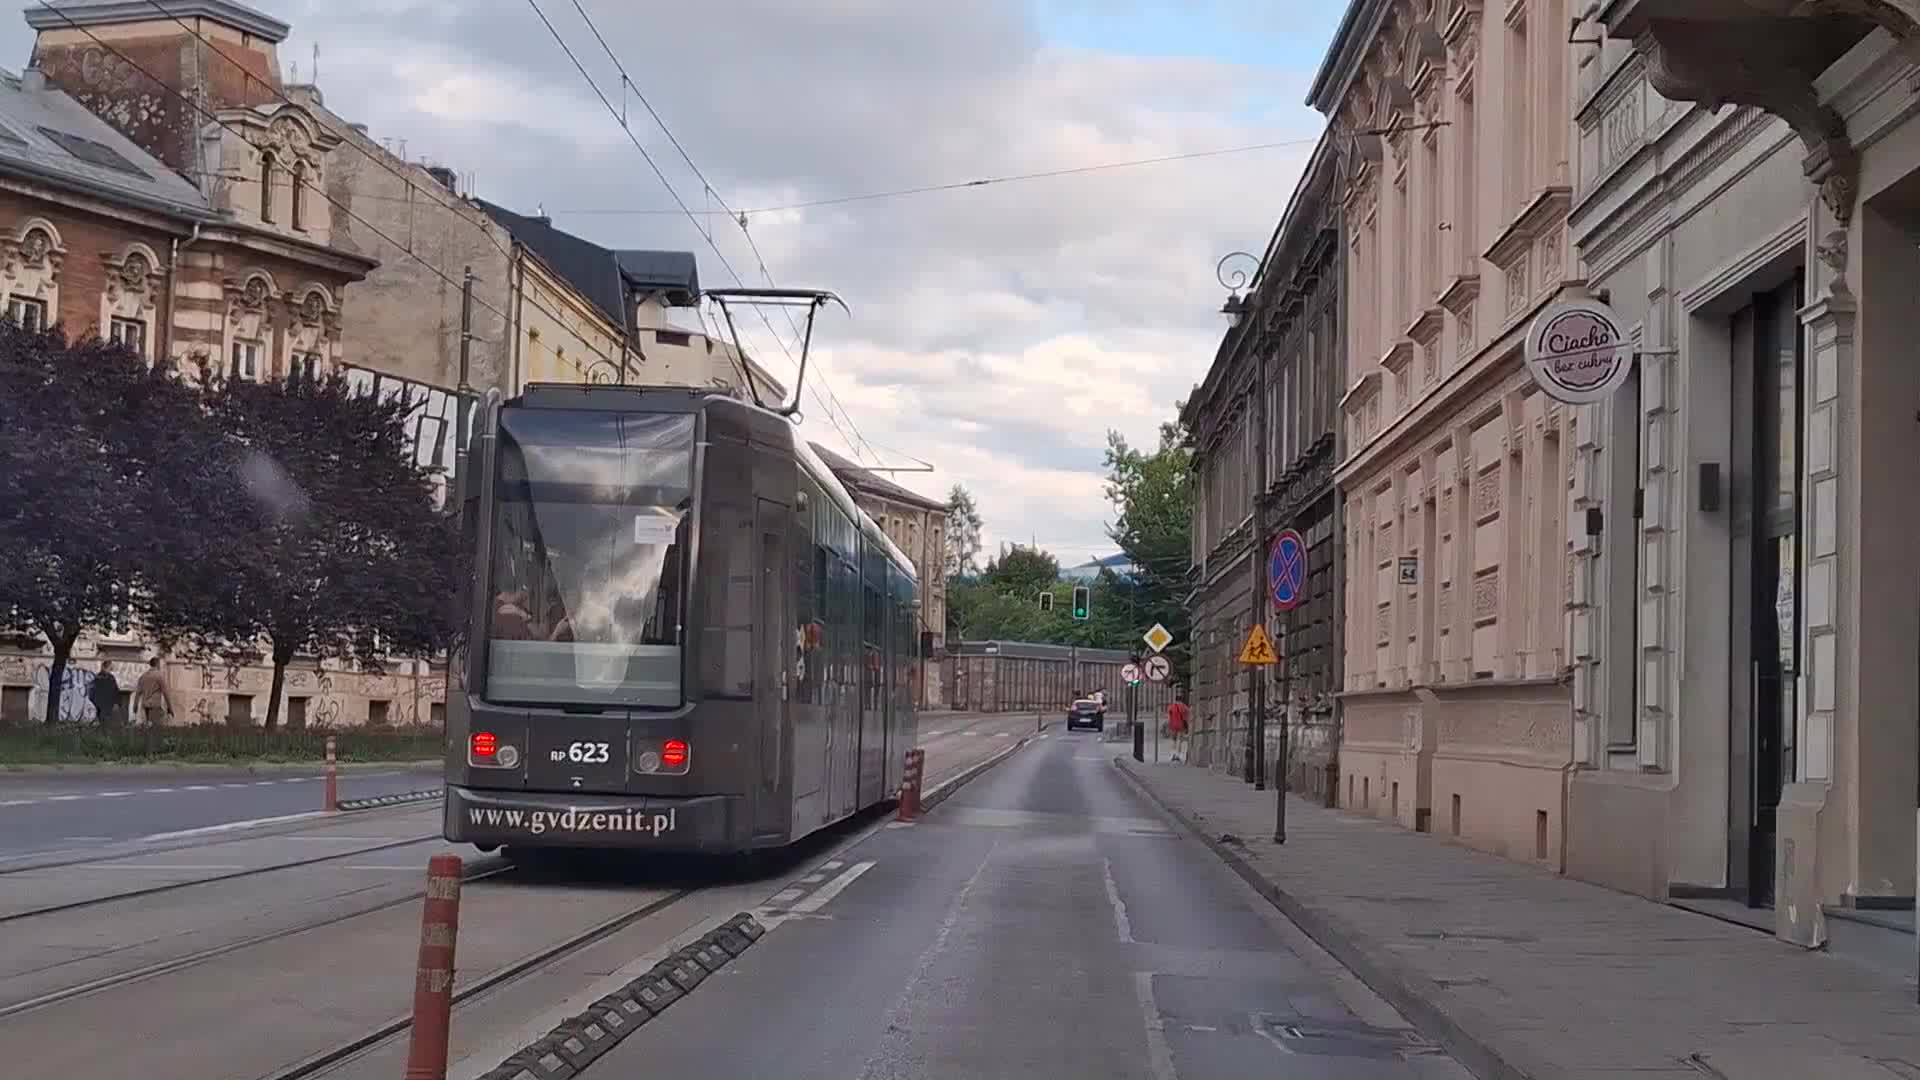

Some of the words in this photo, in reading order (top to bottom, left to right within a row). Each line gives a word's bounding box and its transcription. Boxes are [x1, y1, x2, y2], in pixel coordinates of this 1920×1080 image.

[1549, 325, 1609, 353] Ciacho
[551, 750, 566, 761] RP
[568, 742, 609, 763] 623
[469, 806, 676, 837] www.gvdzenit.pl
